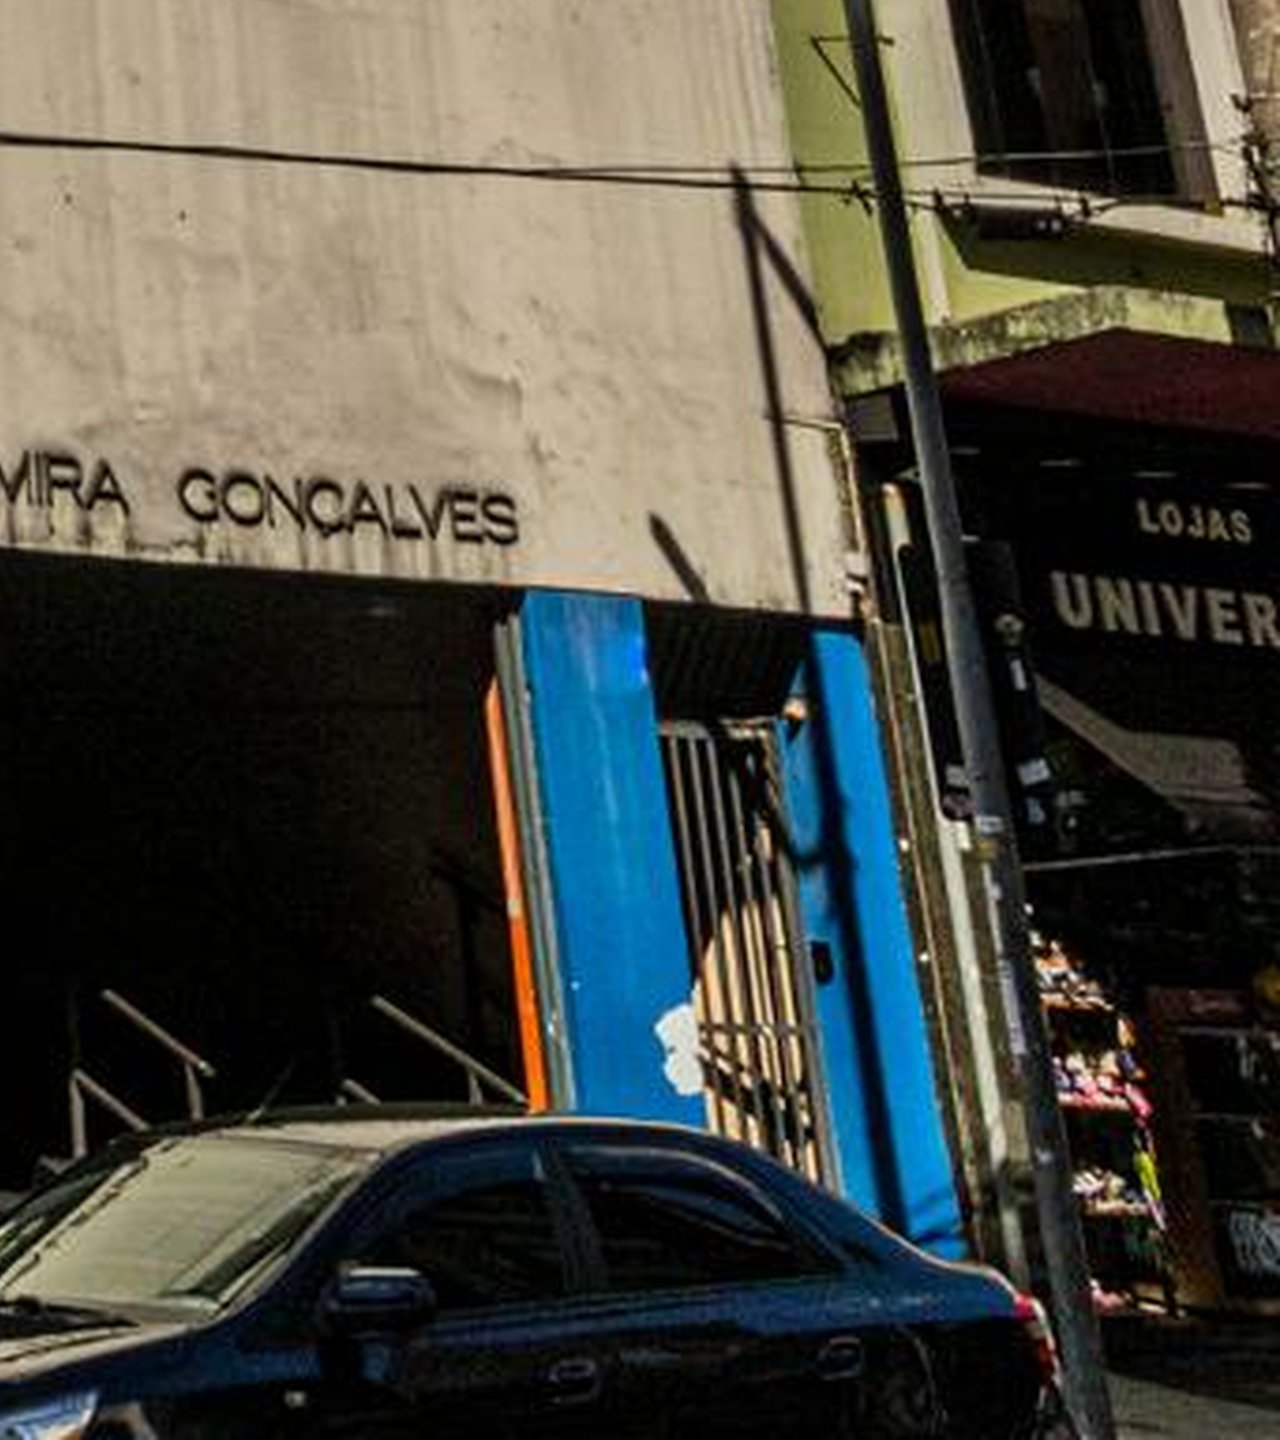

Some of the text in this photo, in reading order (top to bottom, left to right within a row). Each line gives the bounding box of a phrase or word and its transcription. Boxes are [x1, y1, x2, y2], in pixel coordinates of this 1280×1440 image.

[177, 466, 520, 546] GONÇALVES
[1133, 496, 1254, 545] LOJAS
[1048, 569, 1280, 653] UNIVER
